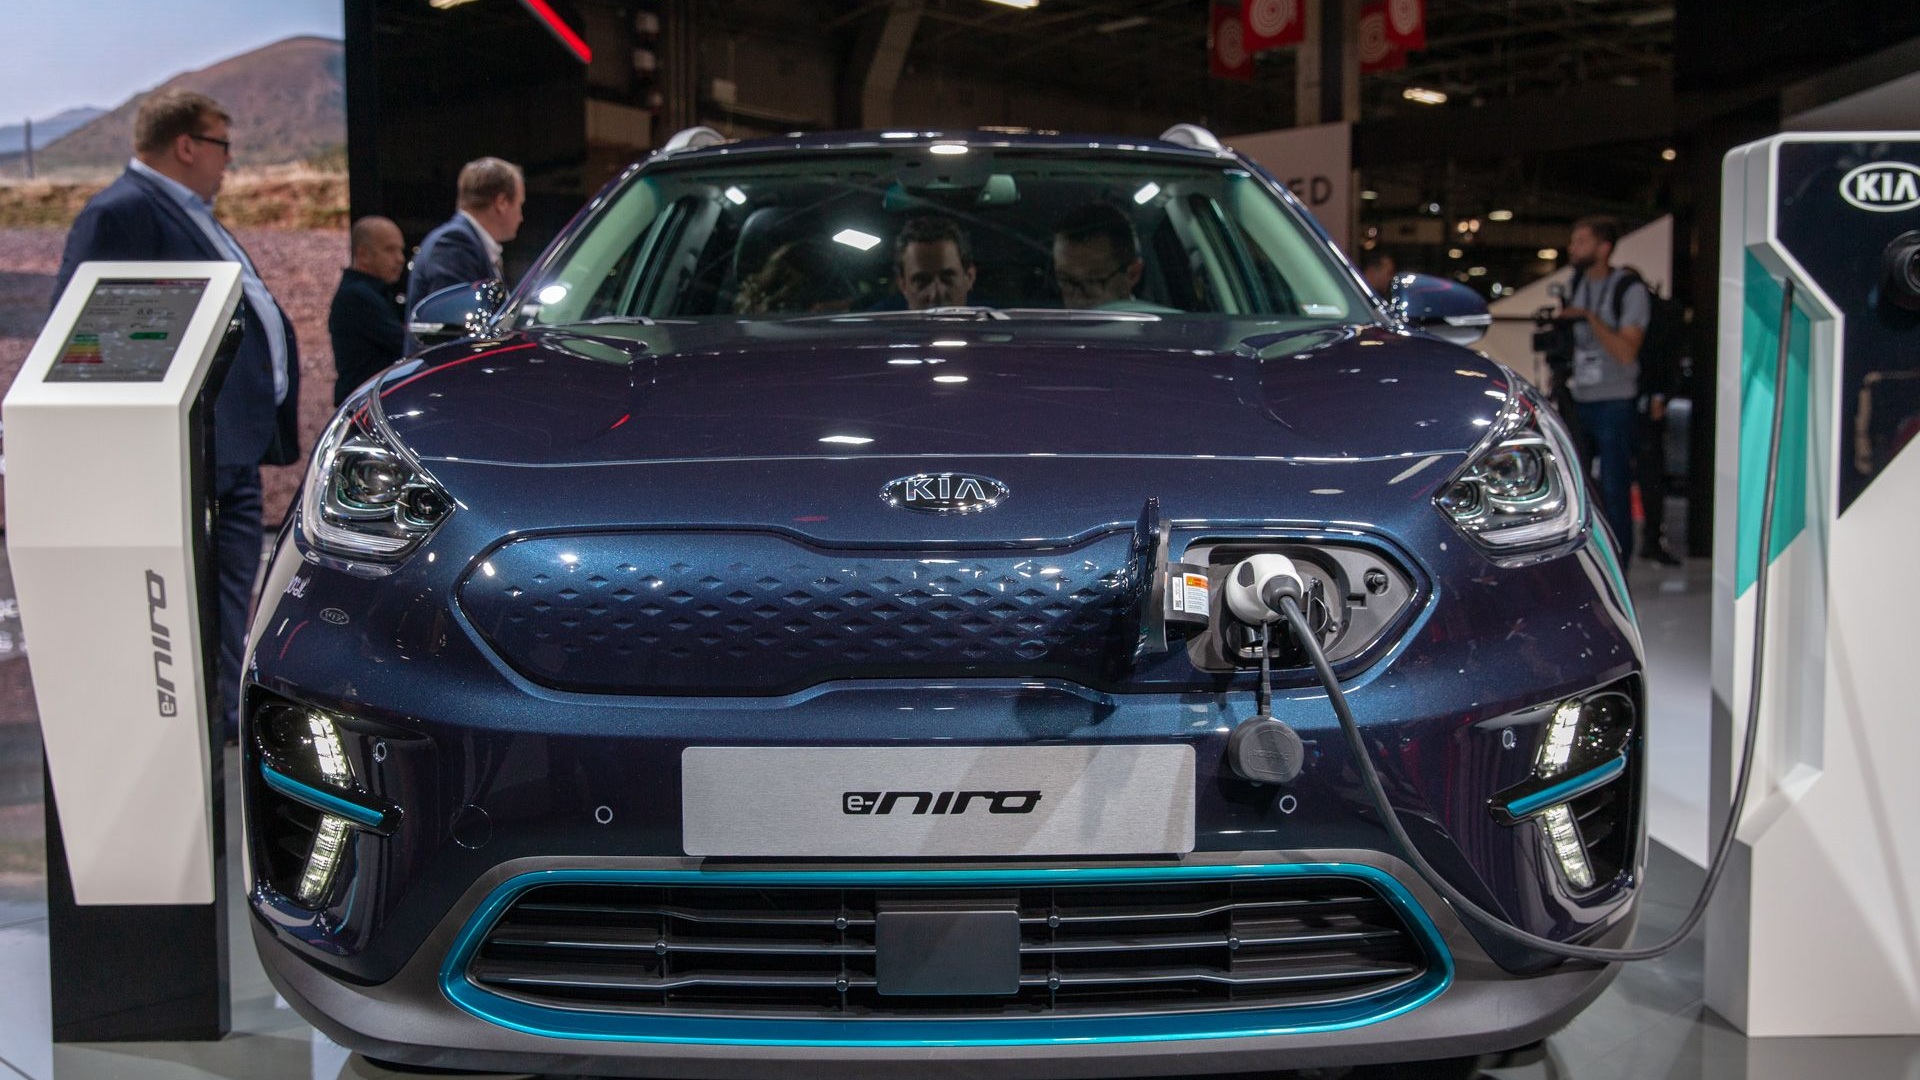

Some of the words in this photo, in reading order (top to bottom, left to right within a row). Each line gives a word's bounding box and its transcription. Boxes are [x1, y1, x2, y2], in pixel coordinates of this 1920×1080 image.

[1857, 172, 1919, 202] KIA
[905, 477, 986, 501] KIA
[146, 569, 177, 717] e-niro
[843, 791, 1043, 815] e-niro
